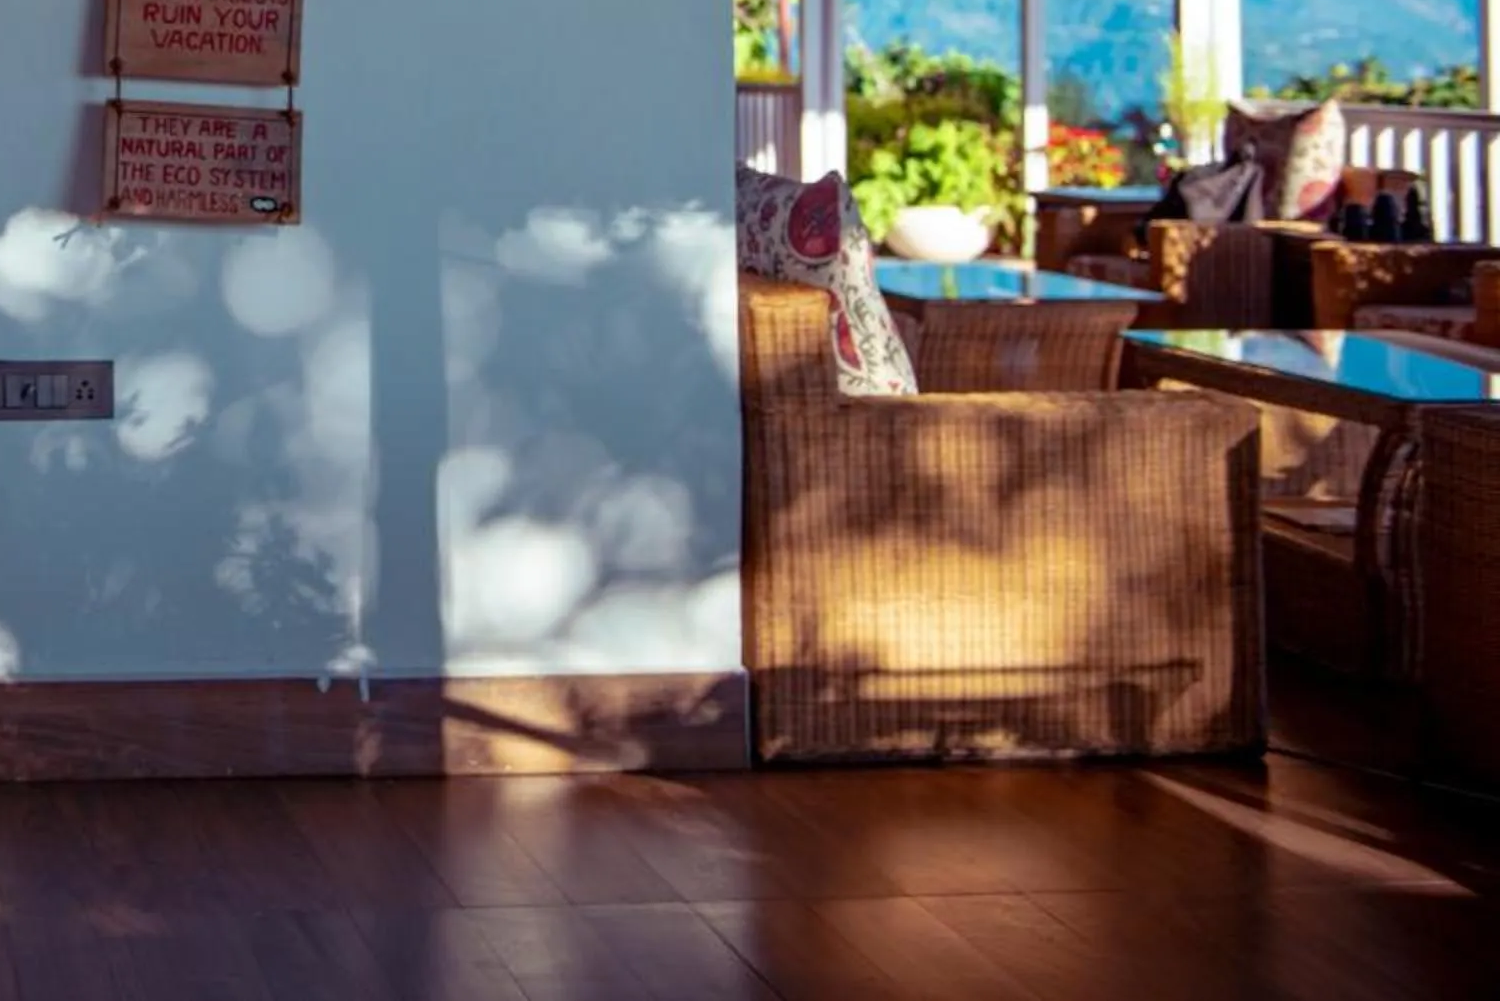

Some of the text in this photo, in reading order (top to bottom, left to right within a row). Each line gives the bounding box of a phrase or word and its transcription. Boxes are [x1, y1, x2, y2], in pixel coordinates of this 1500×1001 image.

[143, 4, 279, 31] RUIN YOUR
[139, 116, 268, 141] THEY ARE A
[121, 138, 288, 164] NATURAL PART OF
[120, 162, 286, 193] THE ECO SYSTEM
[120, 187, 153, 207] AND
